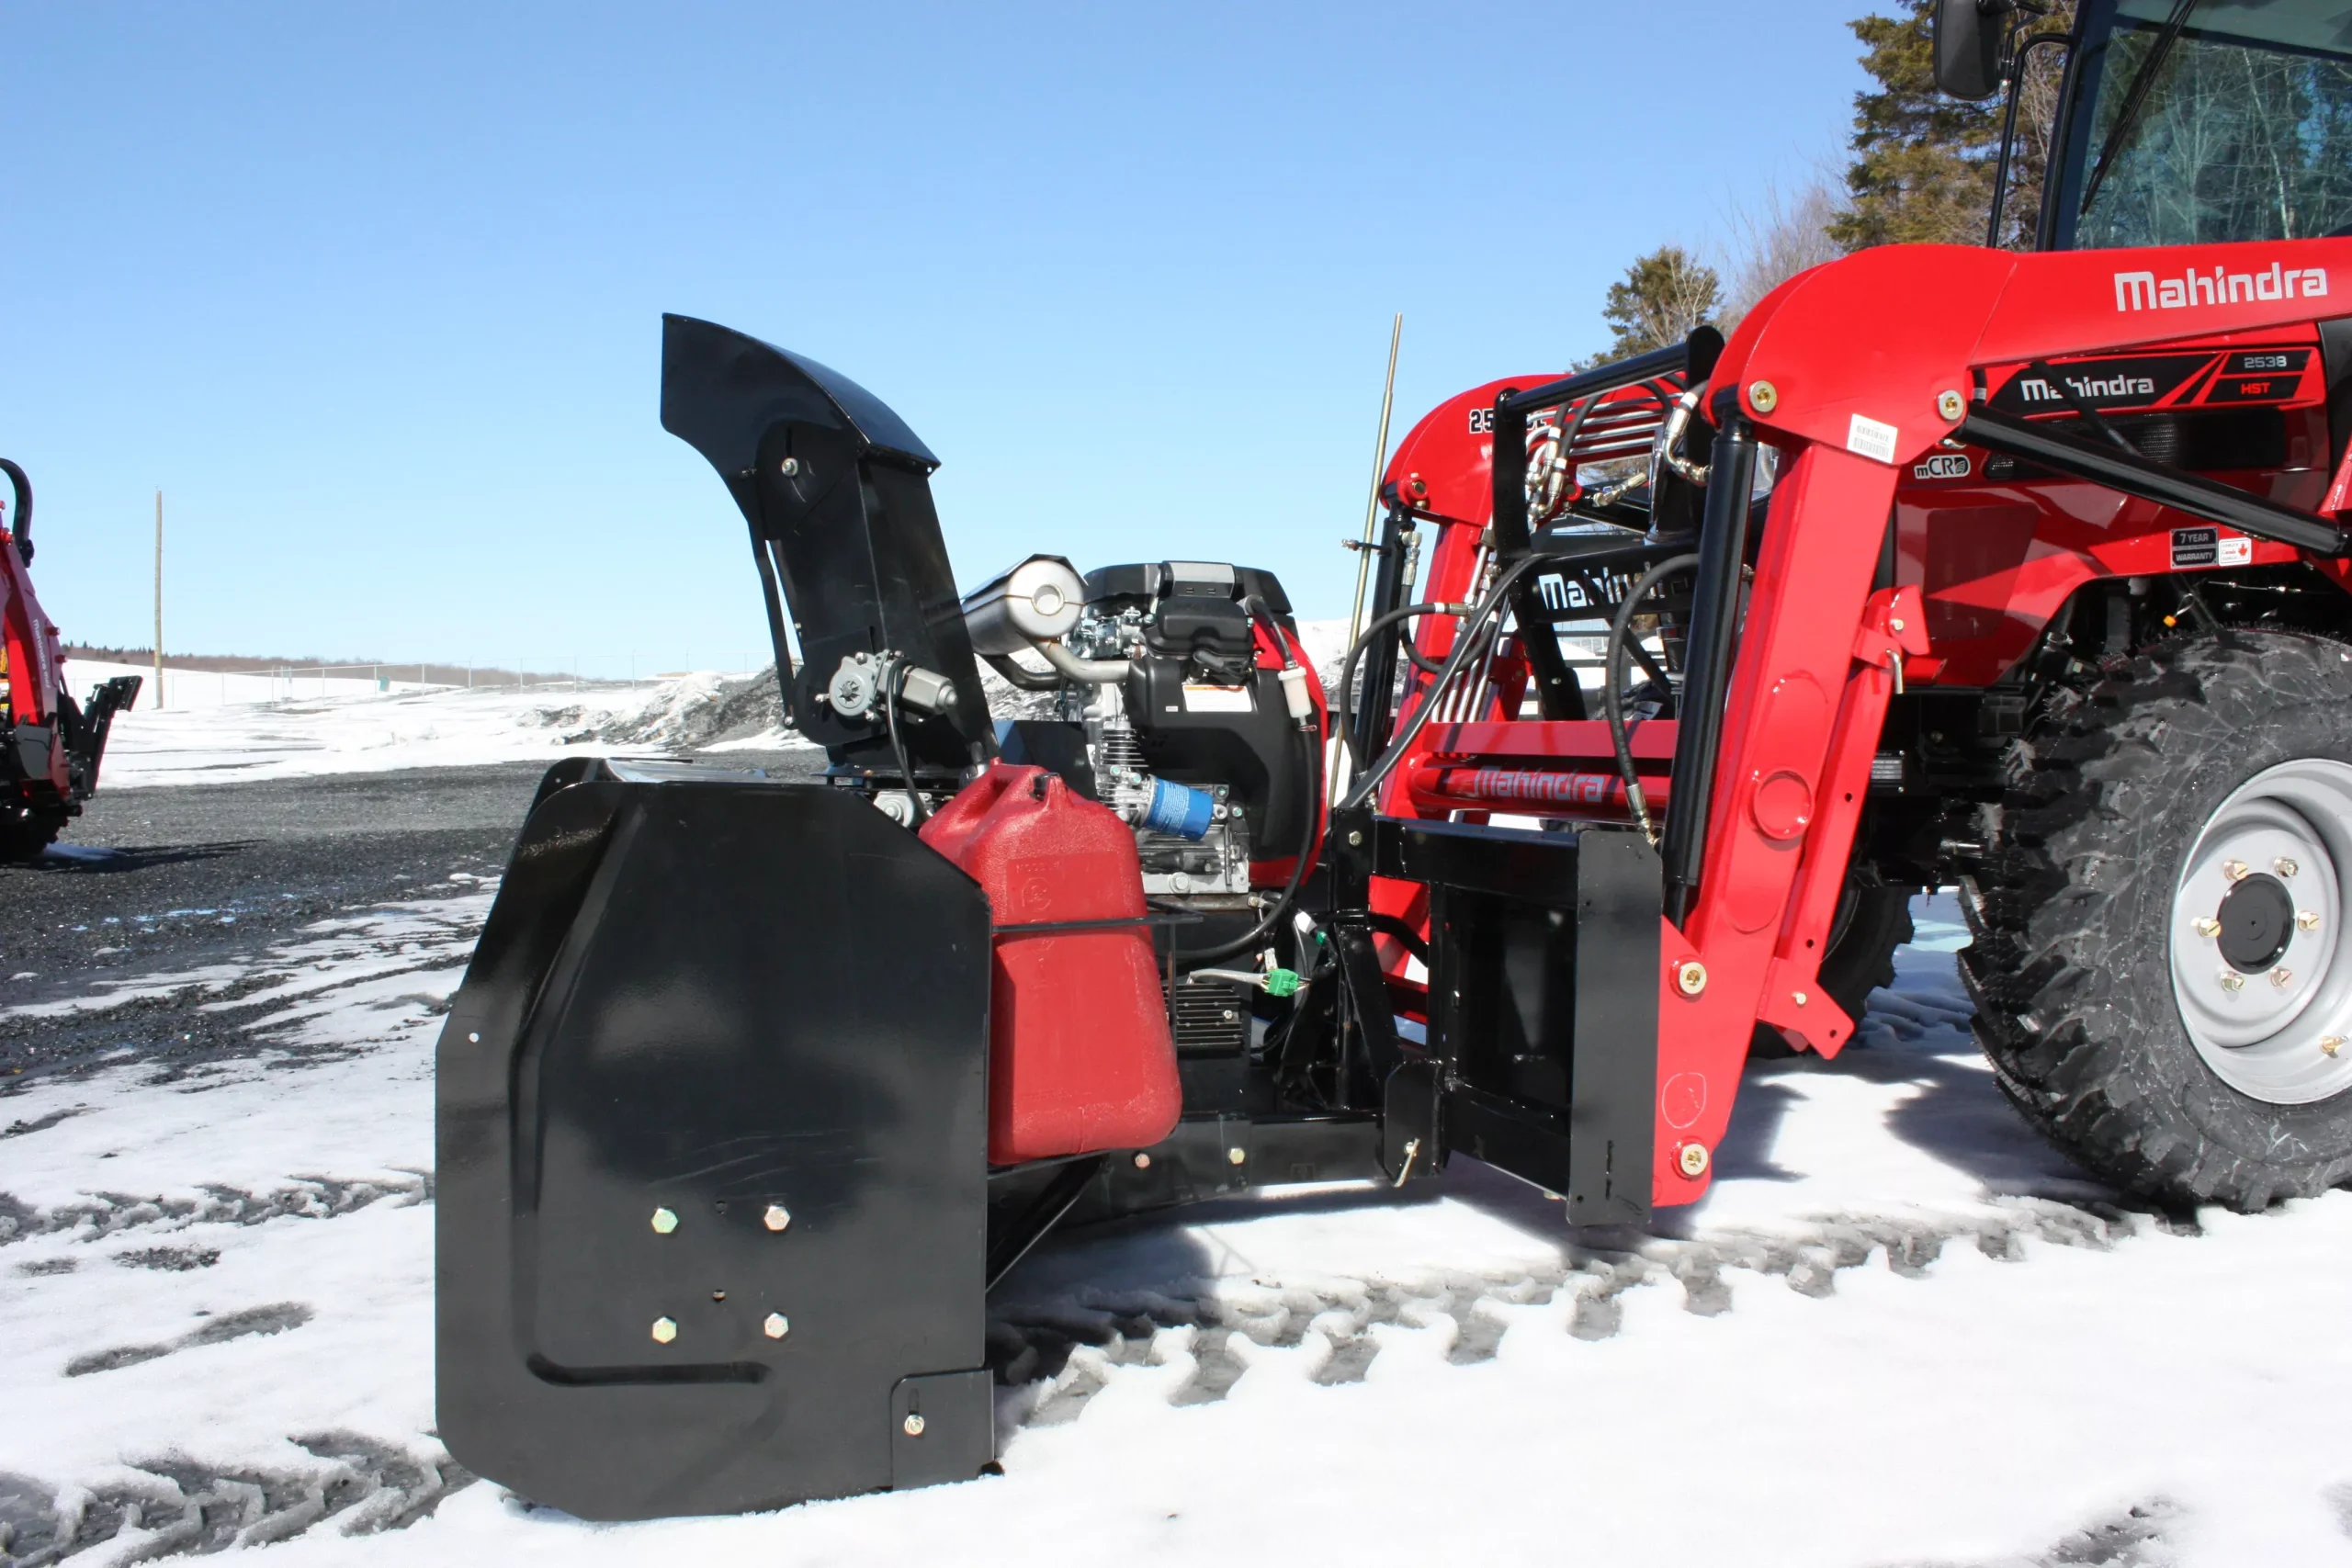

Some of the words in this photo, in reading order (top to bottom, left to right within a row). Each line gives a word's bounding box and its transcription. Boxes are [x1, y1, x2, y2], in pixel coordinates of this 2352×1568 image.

[2114, 262, 2328, 311] Mahindra
[2244, 355, 2287, 369] 2538
[2241, 382, 2271, 395] HST
[2180, 534, 2187, 544] 7
[2188, 533, 2210, 543] YEAR
[2176, 552, 2213, 562] WARRANTY
[1474, 765, 1605, 803] Mahindra
